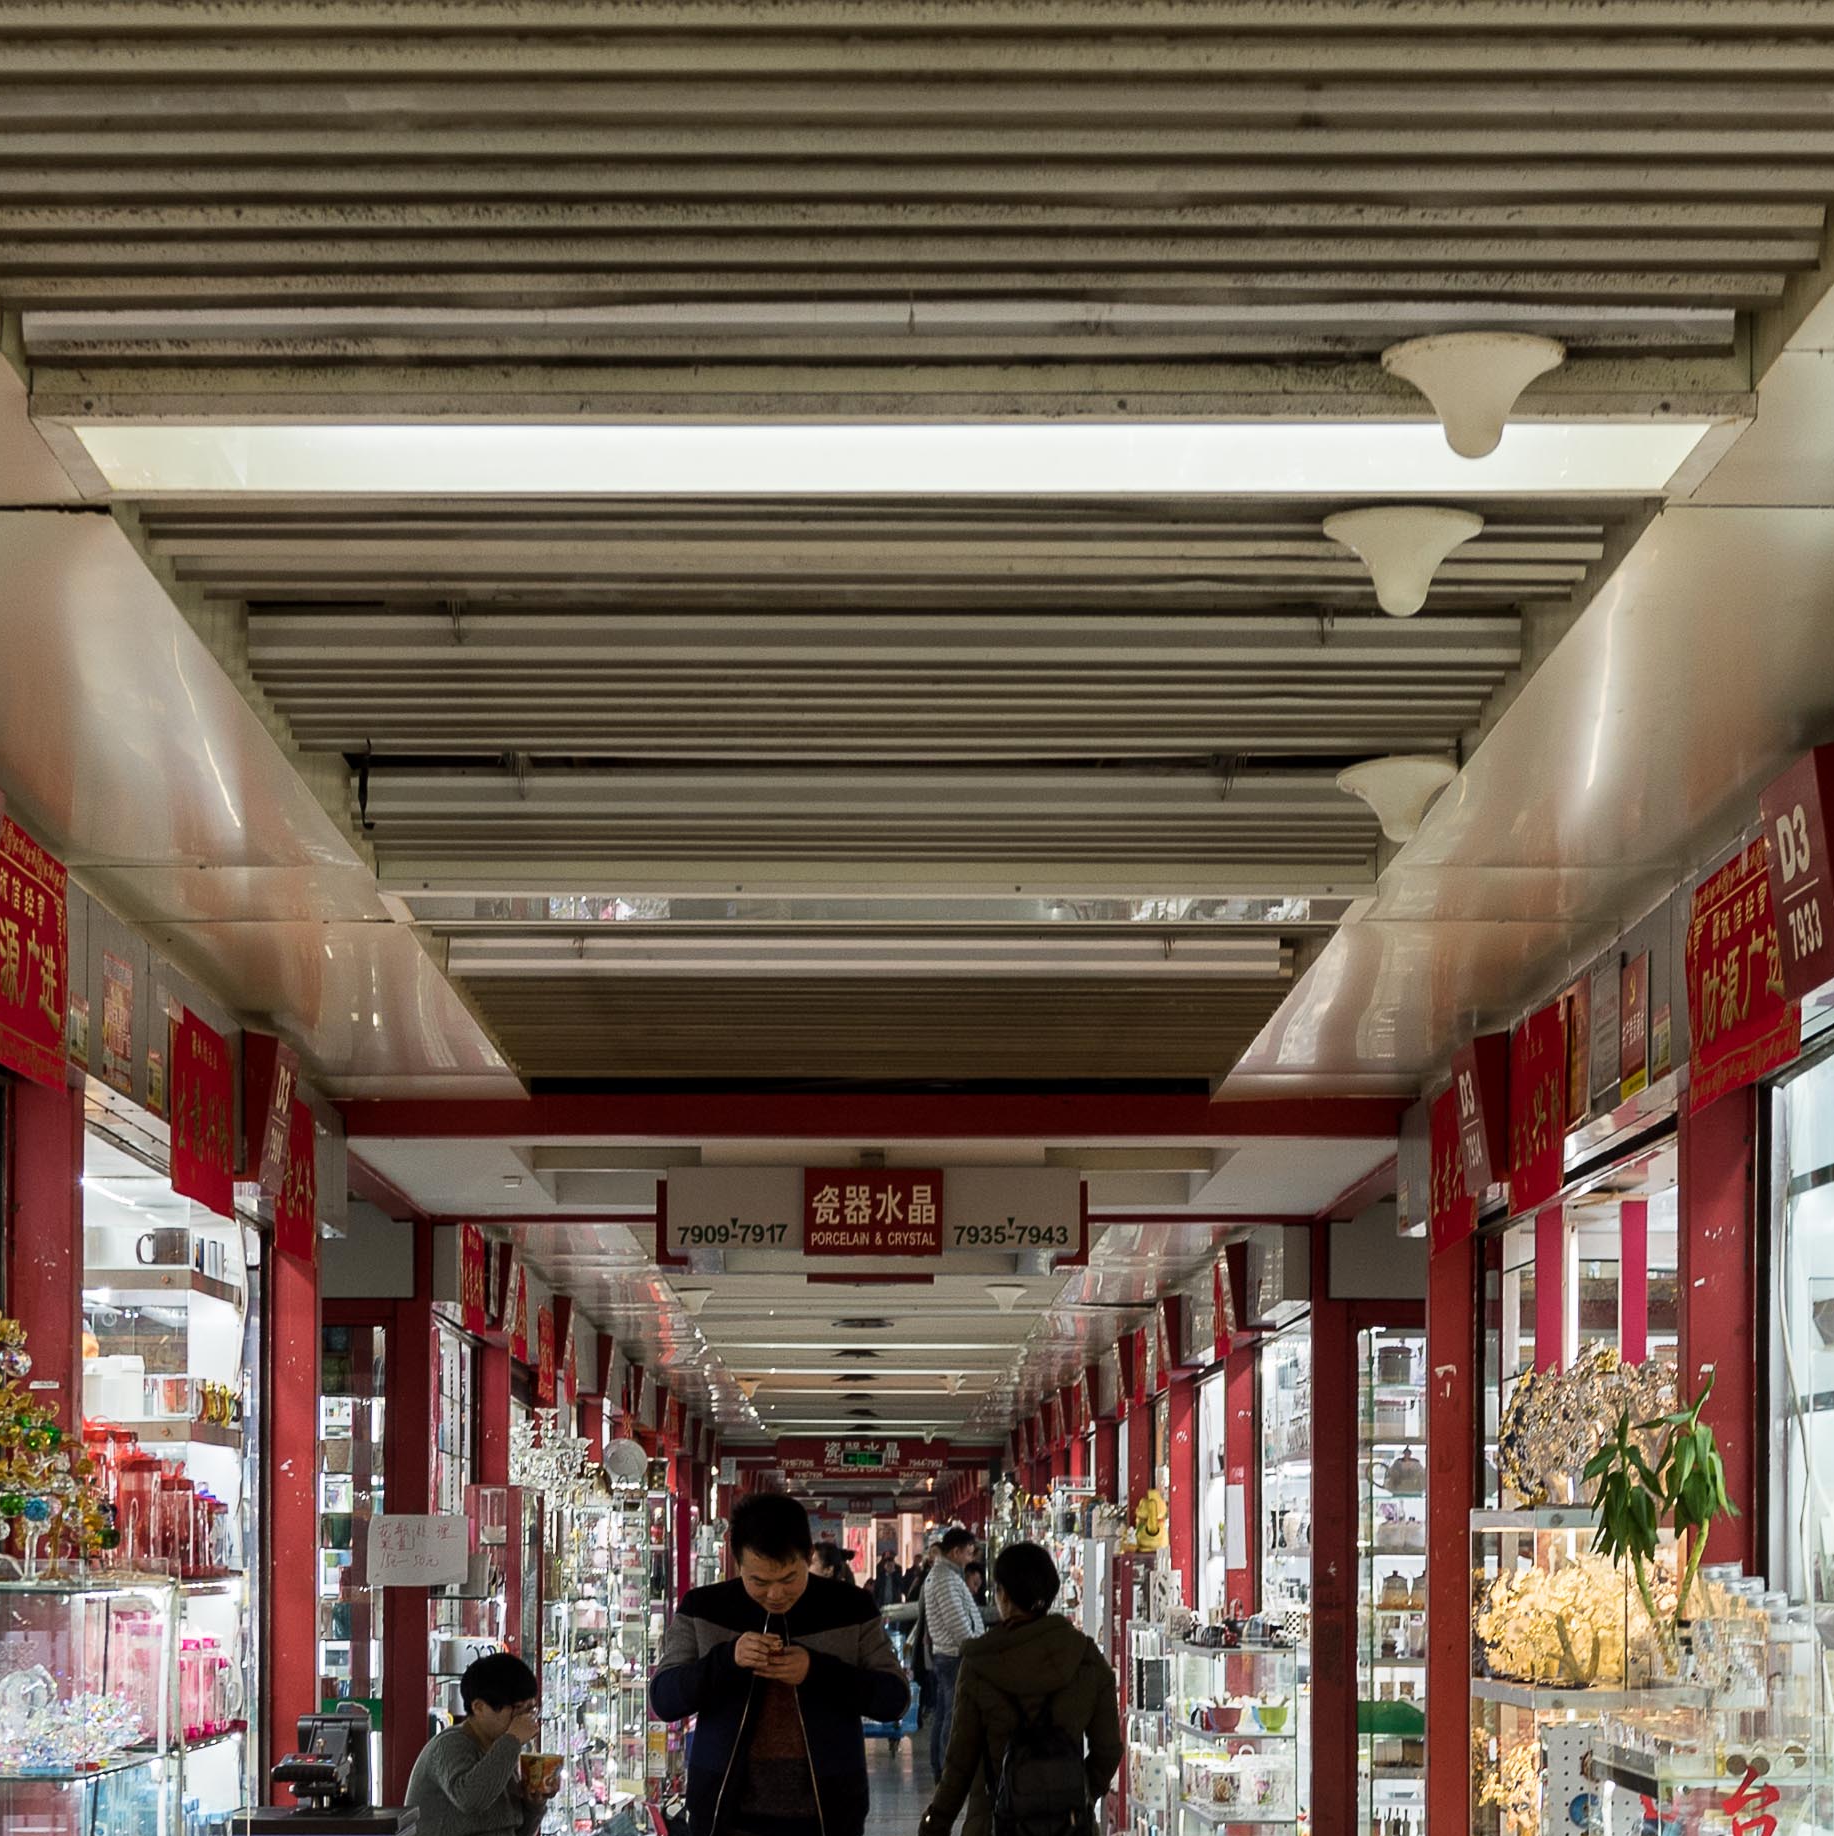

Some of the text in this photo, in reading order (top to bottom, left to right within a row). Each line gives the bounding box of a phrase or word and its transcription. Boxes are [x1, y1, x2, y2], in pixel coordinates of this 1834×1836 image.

[1775, 803, 1812, 885] D3
[1787, 898, 1824, 962] 7933
[275, 1064, 291, 1115] D3
[1458, 1069, 1476, 1120] D3
[812, 1184, 937, 1225] 瓷器水晶
[677, 1223, 789, 1246] 7909-7917
[874, 1230, 883, 1247] &
[887, 1230, 937, 1247] CRYSTAL
[953, 1224, 1069, 1246] 7935-7943
